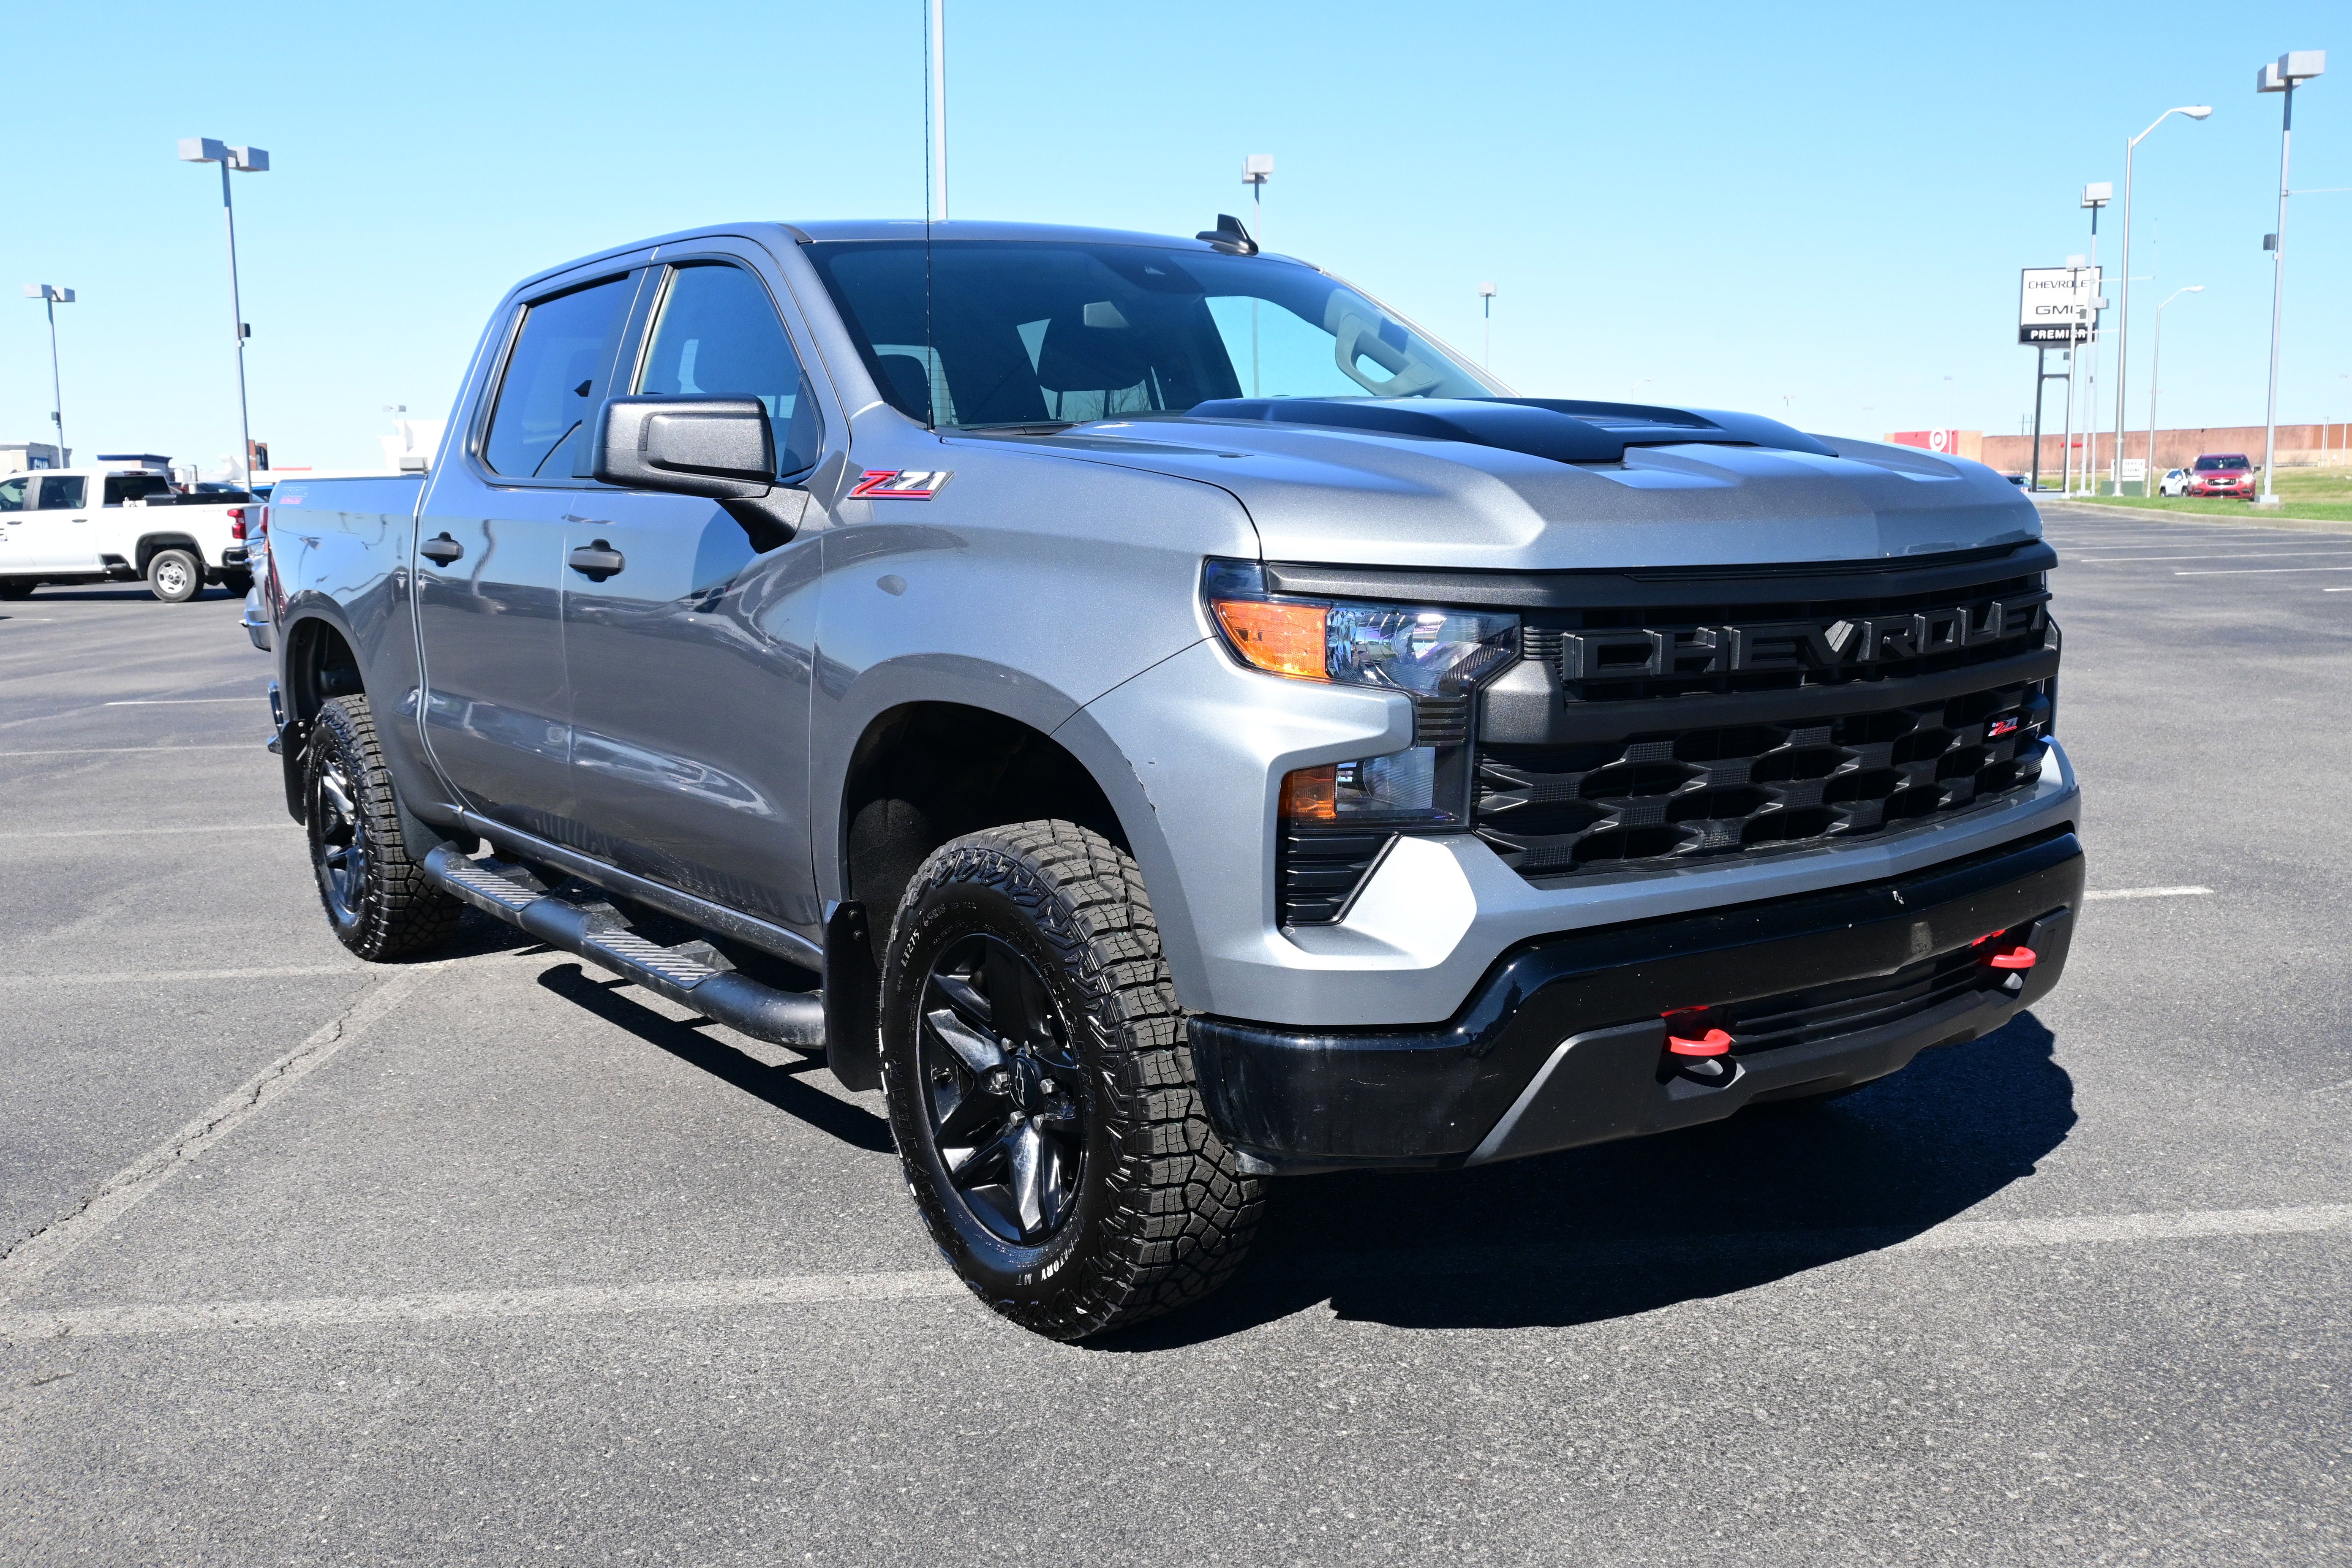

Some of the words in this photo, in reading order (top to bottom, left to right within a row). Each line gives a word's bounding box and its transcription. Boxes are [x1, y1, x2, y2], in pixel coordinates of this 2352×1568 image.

[2028, 279, 2091, 289] CHEVROE
[847, 468, 956, 501] Z71
[1563, 591, 2053, 681] CHEVROLET
